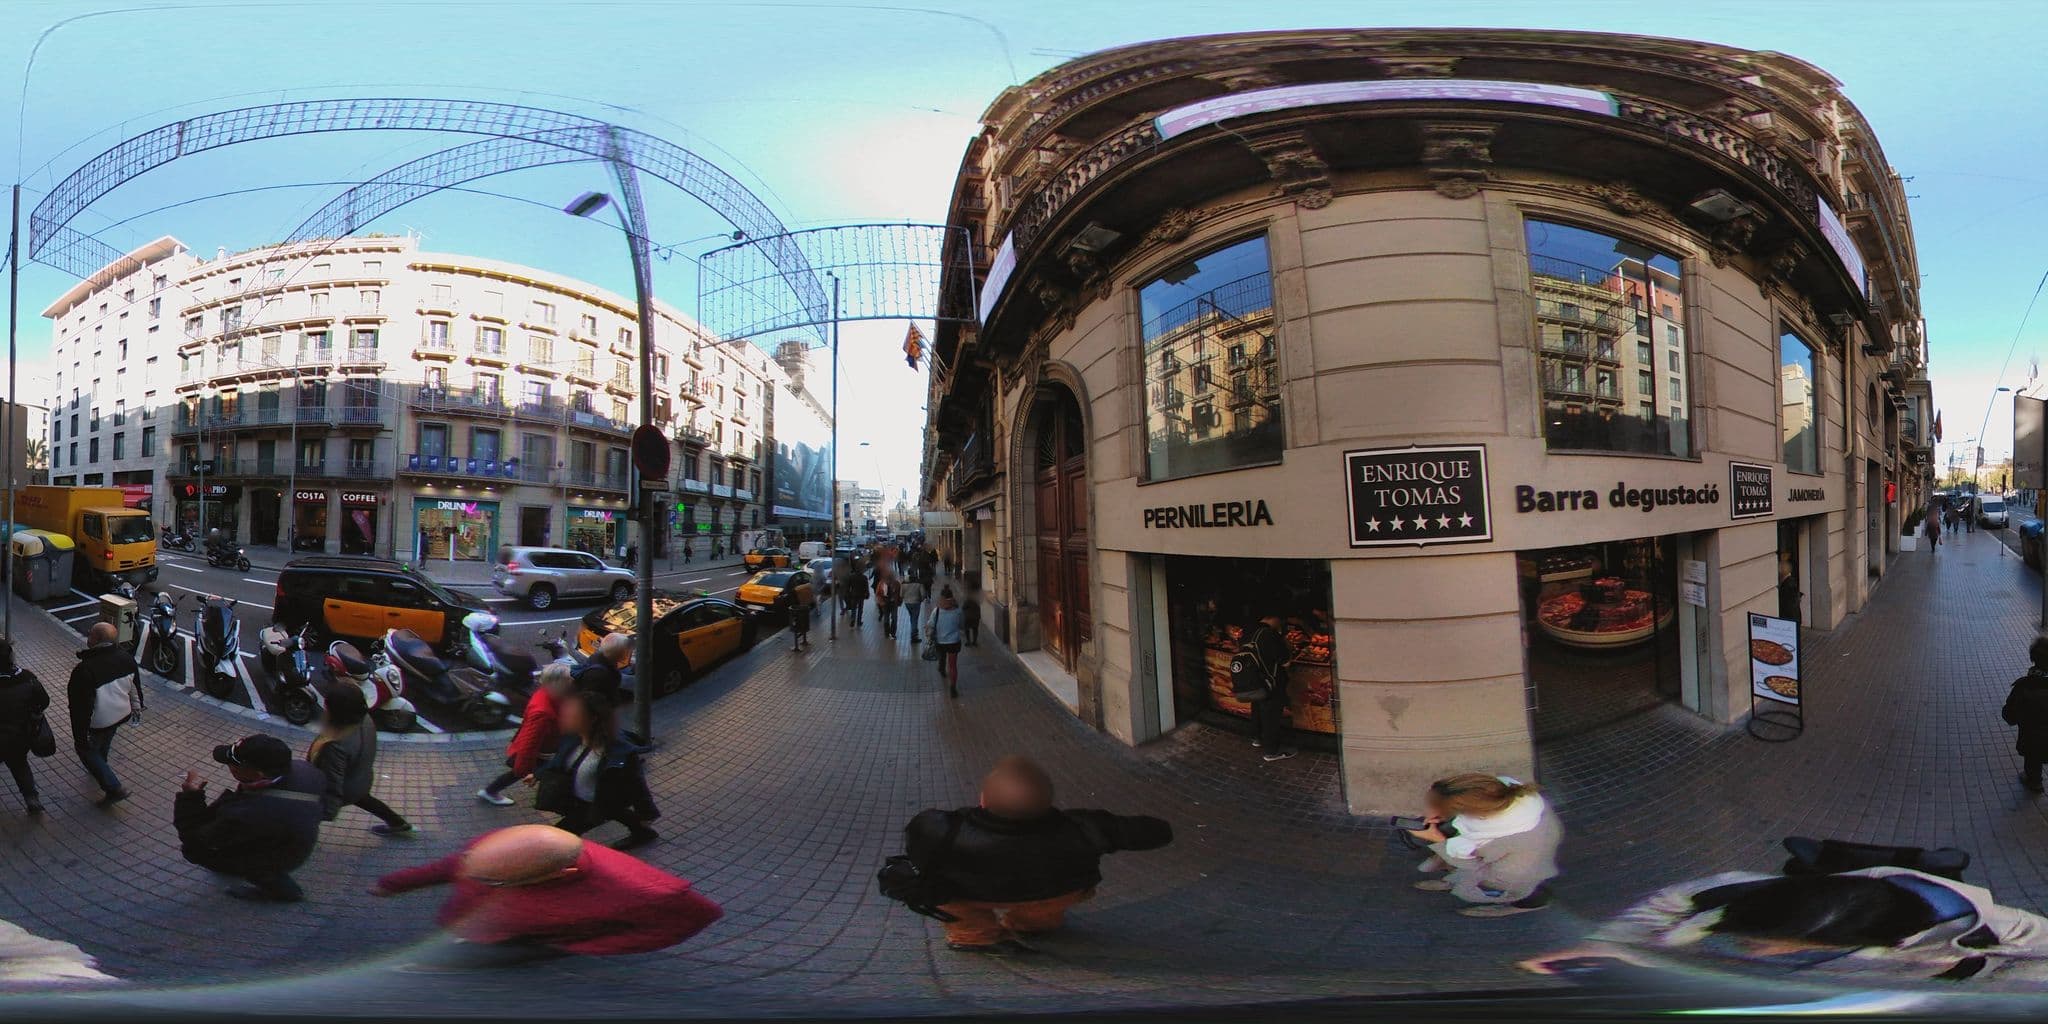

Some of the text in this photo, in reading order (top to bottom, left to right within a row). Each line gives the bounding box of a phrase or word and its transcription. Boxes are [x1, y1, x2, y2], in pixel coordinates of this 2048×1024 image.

[1361, 460, 1472, 485] ENRIQUE
[1736, 471, 1769, 485] ENRIQUE
[296, 491, 376, 502] COSTA COFFEE
[1374, 485, 1461, 508] TOMAS
[1515, 482, 1720, 513] Barra degustació
[1741, 485, 1767, 497] TOMAS
[437, 501, 466, 511] DRUNI
[584, 510, 605, 518] DRUNI
[1144, 499, 1273, 529] PERNILERIA
